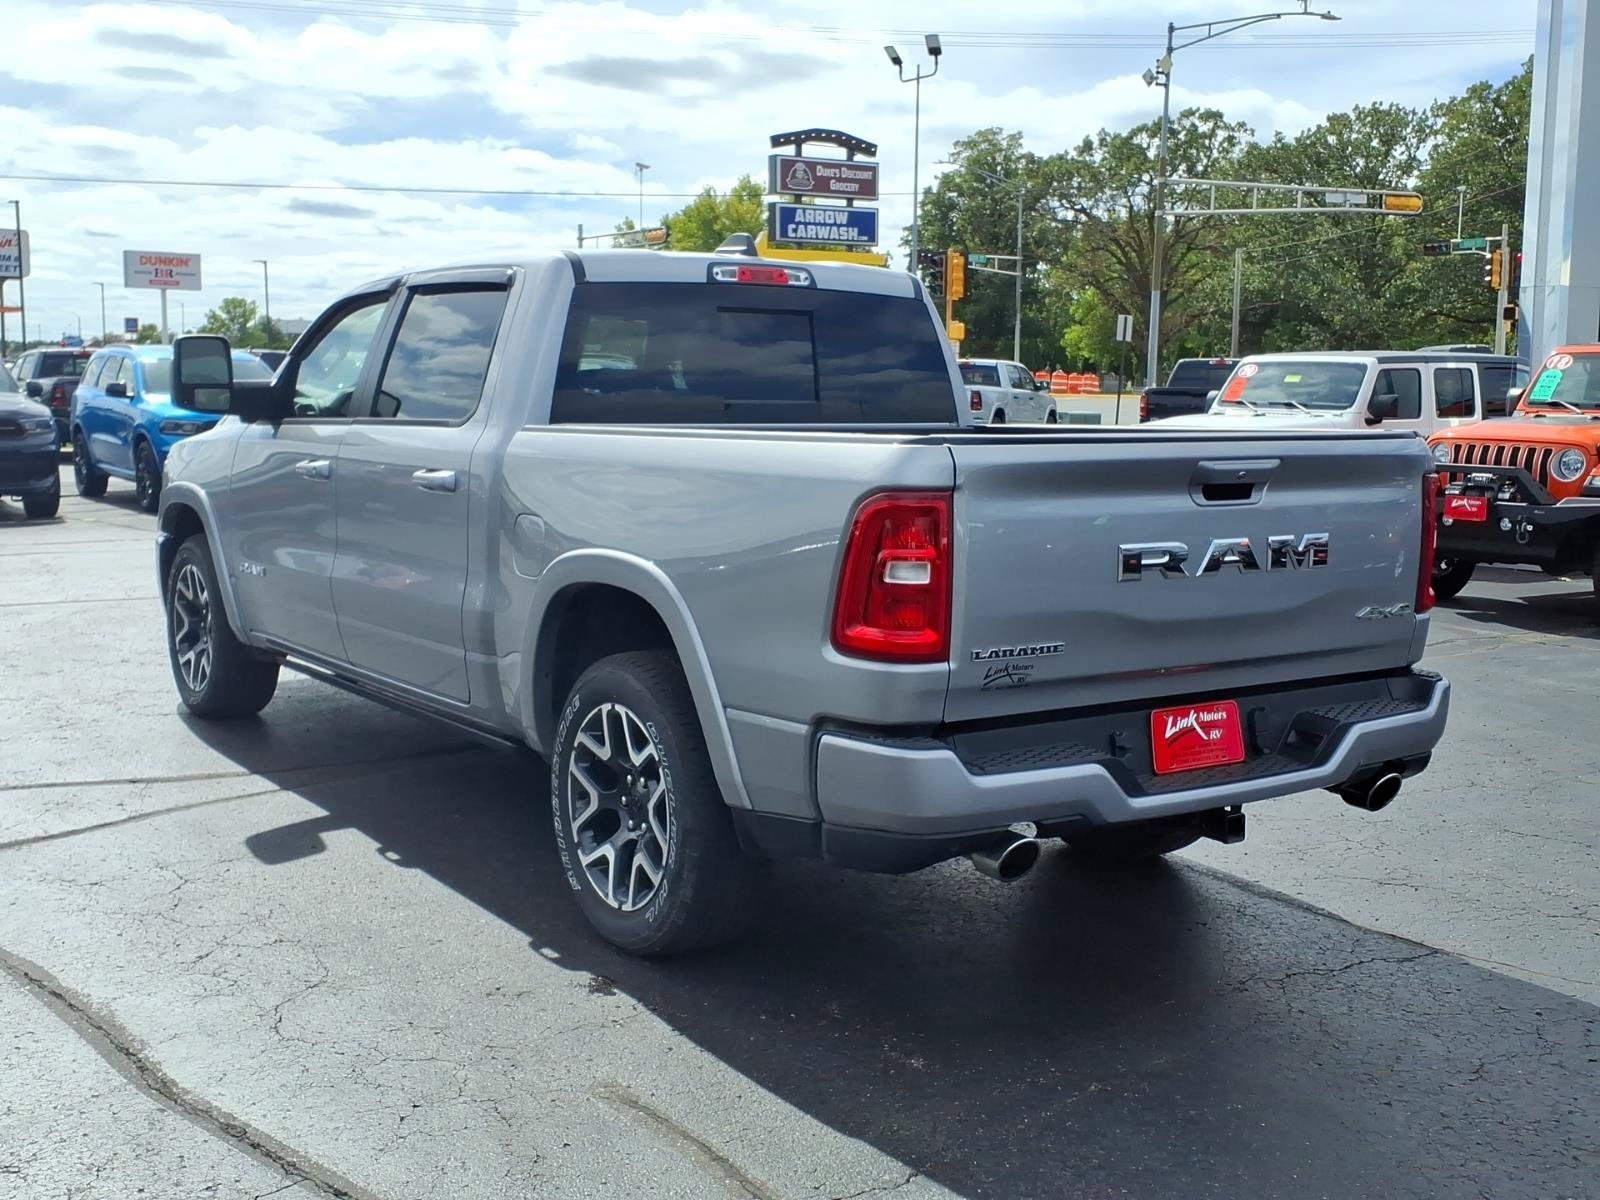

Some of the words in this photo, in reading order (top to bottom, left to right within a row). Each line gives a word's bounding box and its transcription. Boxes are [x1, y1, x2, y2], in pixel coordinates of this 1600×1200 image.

[830, 180, 859, 192] GROCERY
[794, 208, 848, 224] ARROW
[140, 255, 192, 268] DUNKIN'
[1117, 533, 1329, 582] RAM
[971, 643, 1064, 662] LARAMIE
[984, 662, 1014, 684] Link
[1012, 664, 1034, 672] Motors
[1164, 709, 1208, 740] Link
[1199, 711, 1227, 722] Motors
[1210, 729, 1223, 740] RV
